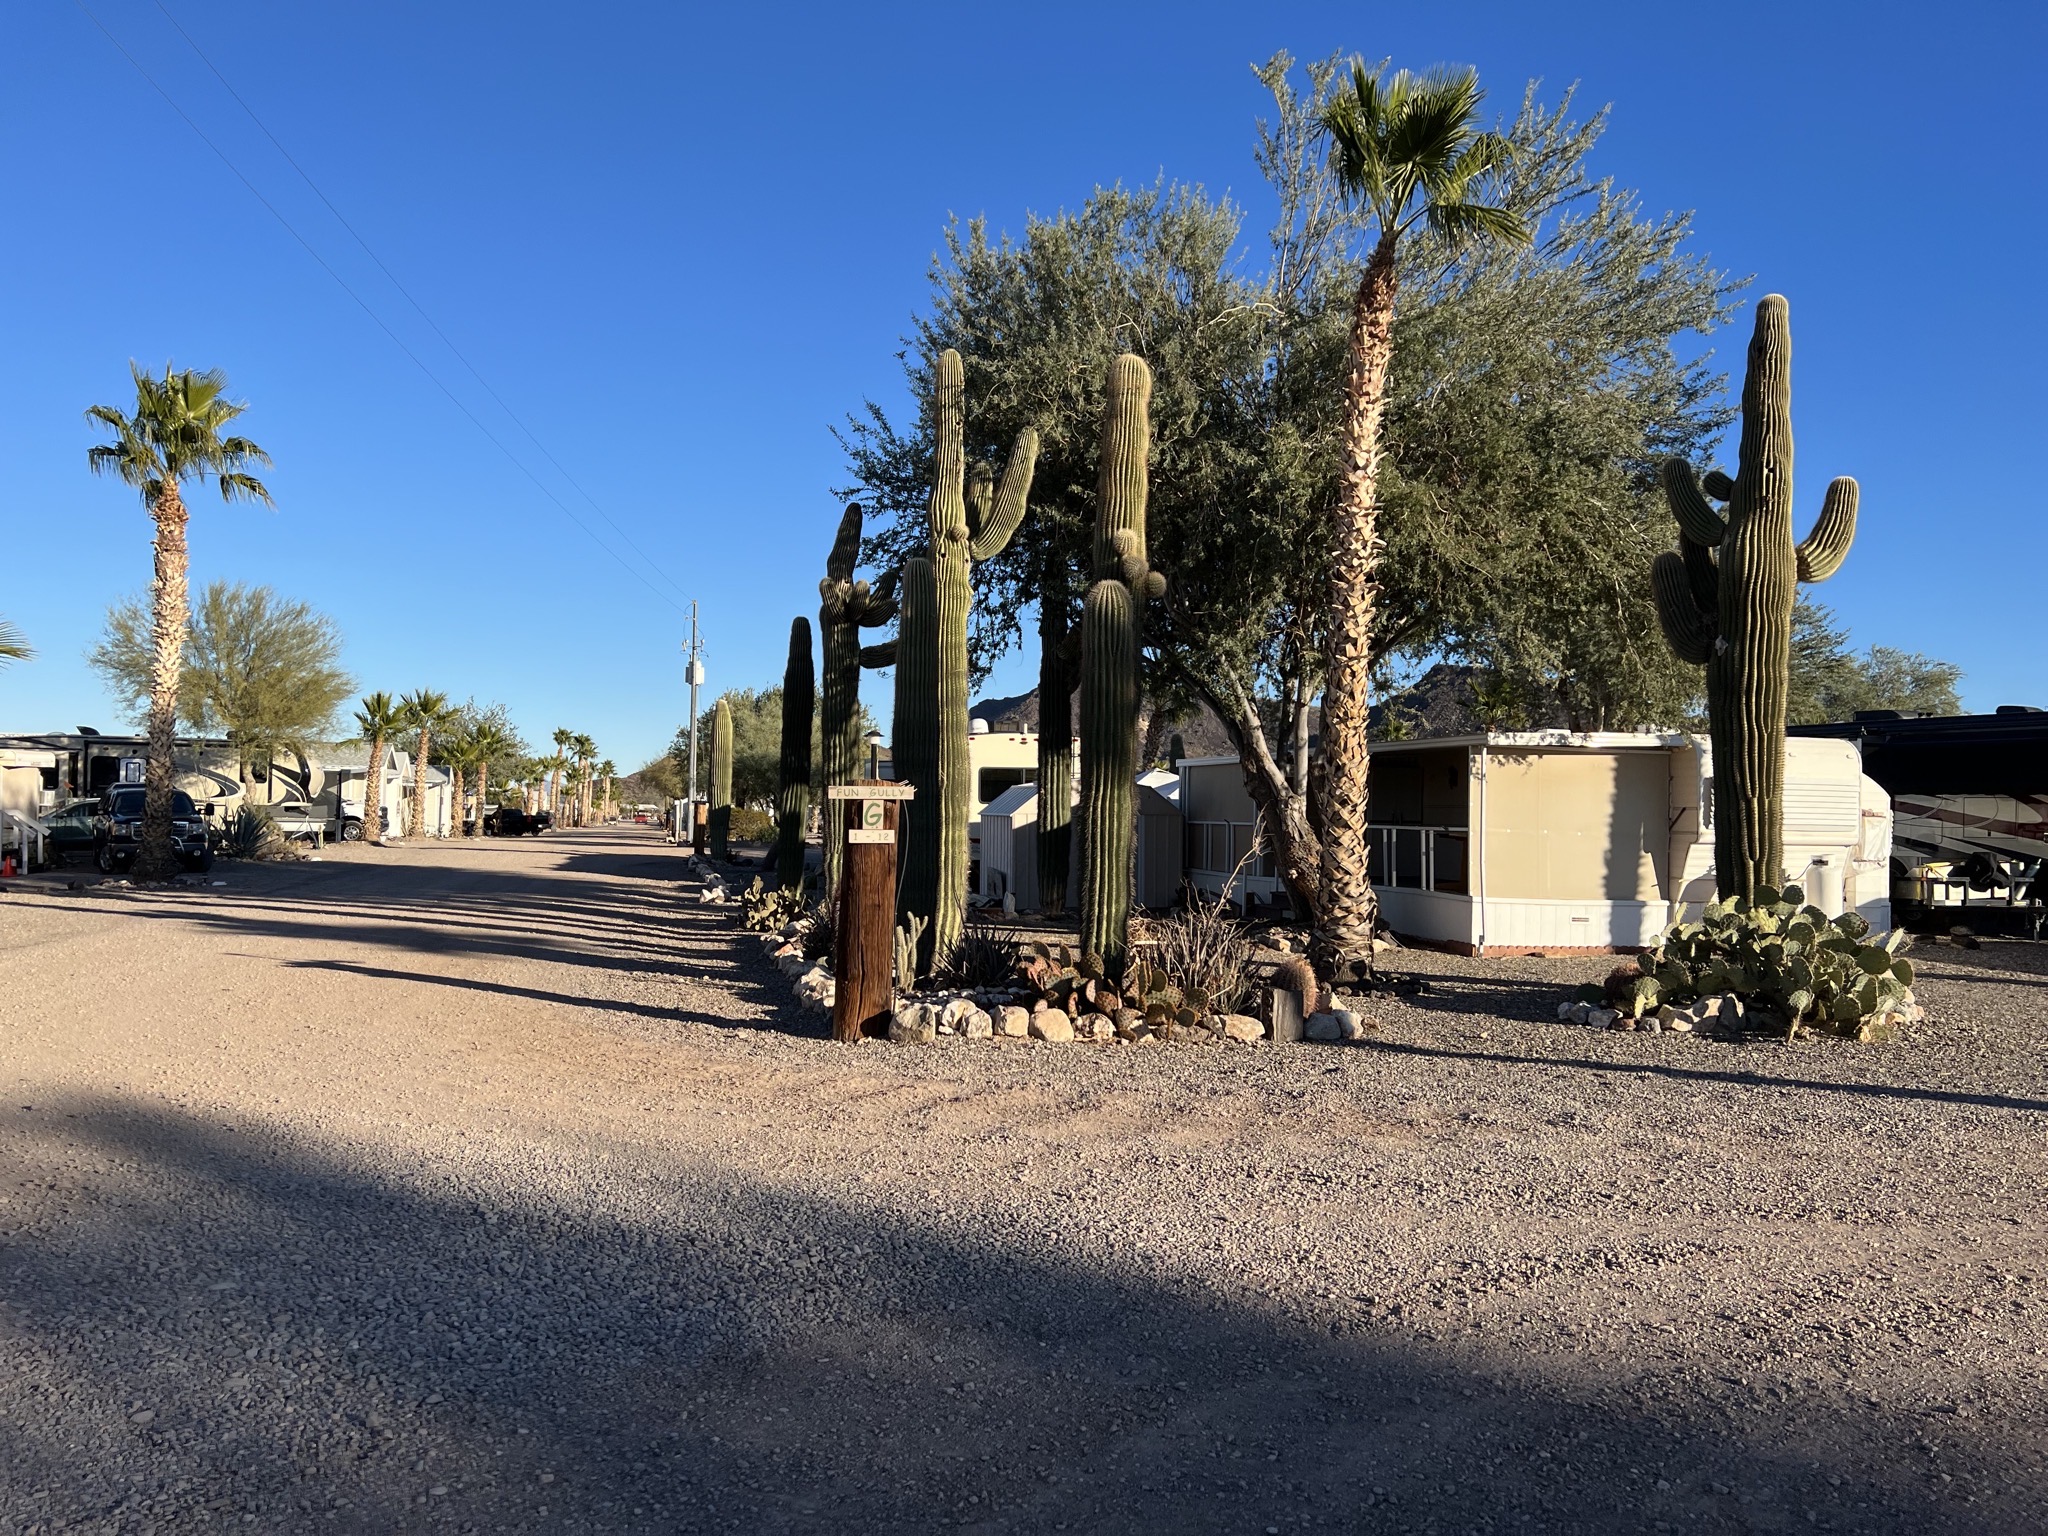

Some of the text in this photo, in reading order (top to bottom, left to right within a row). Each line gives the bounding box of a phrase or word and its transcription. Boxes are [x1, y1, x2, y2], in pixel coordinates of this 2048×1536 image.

[836, 788, 904, 797] FUN GULLY
[864, 802, 882, 826] G
[878, 833, 889, 841] 12
